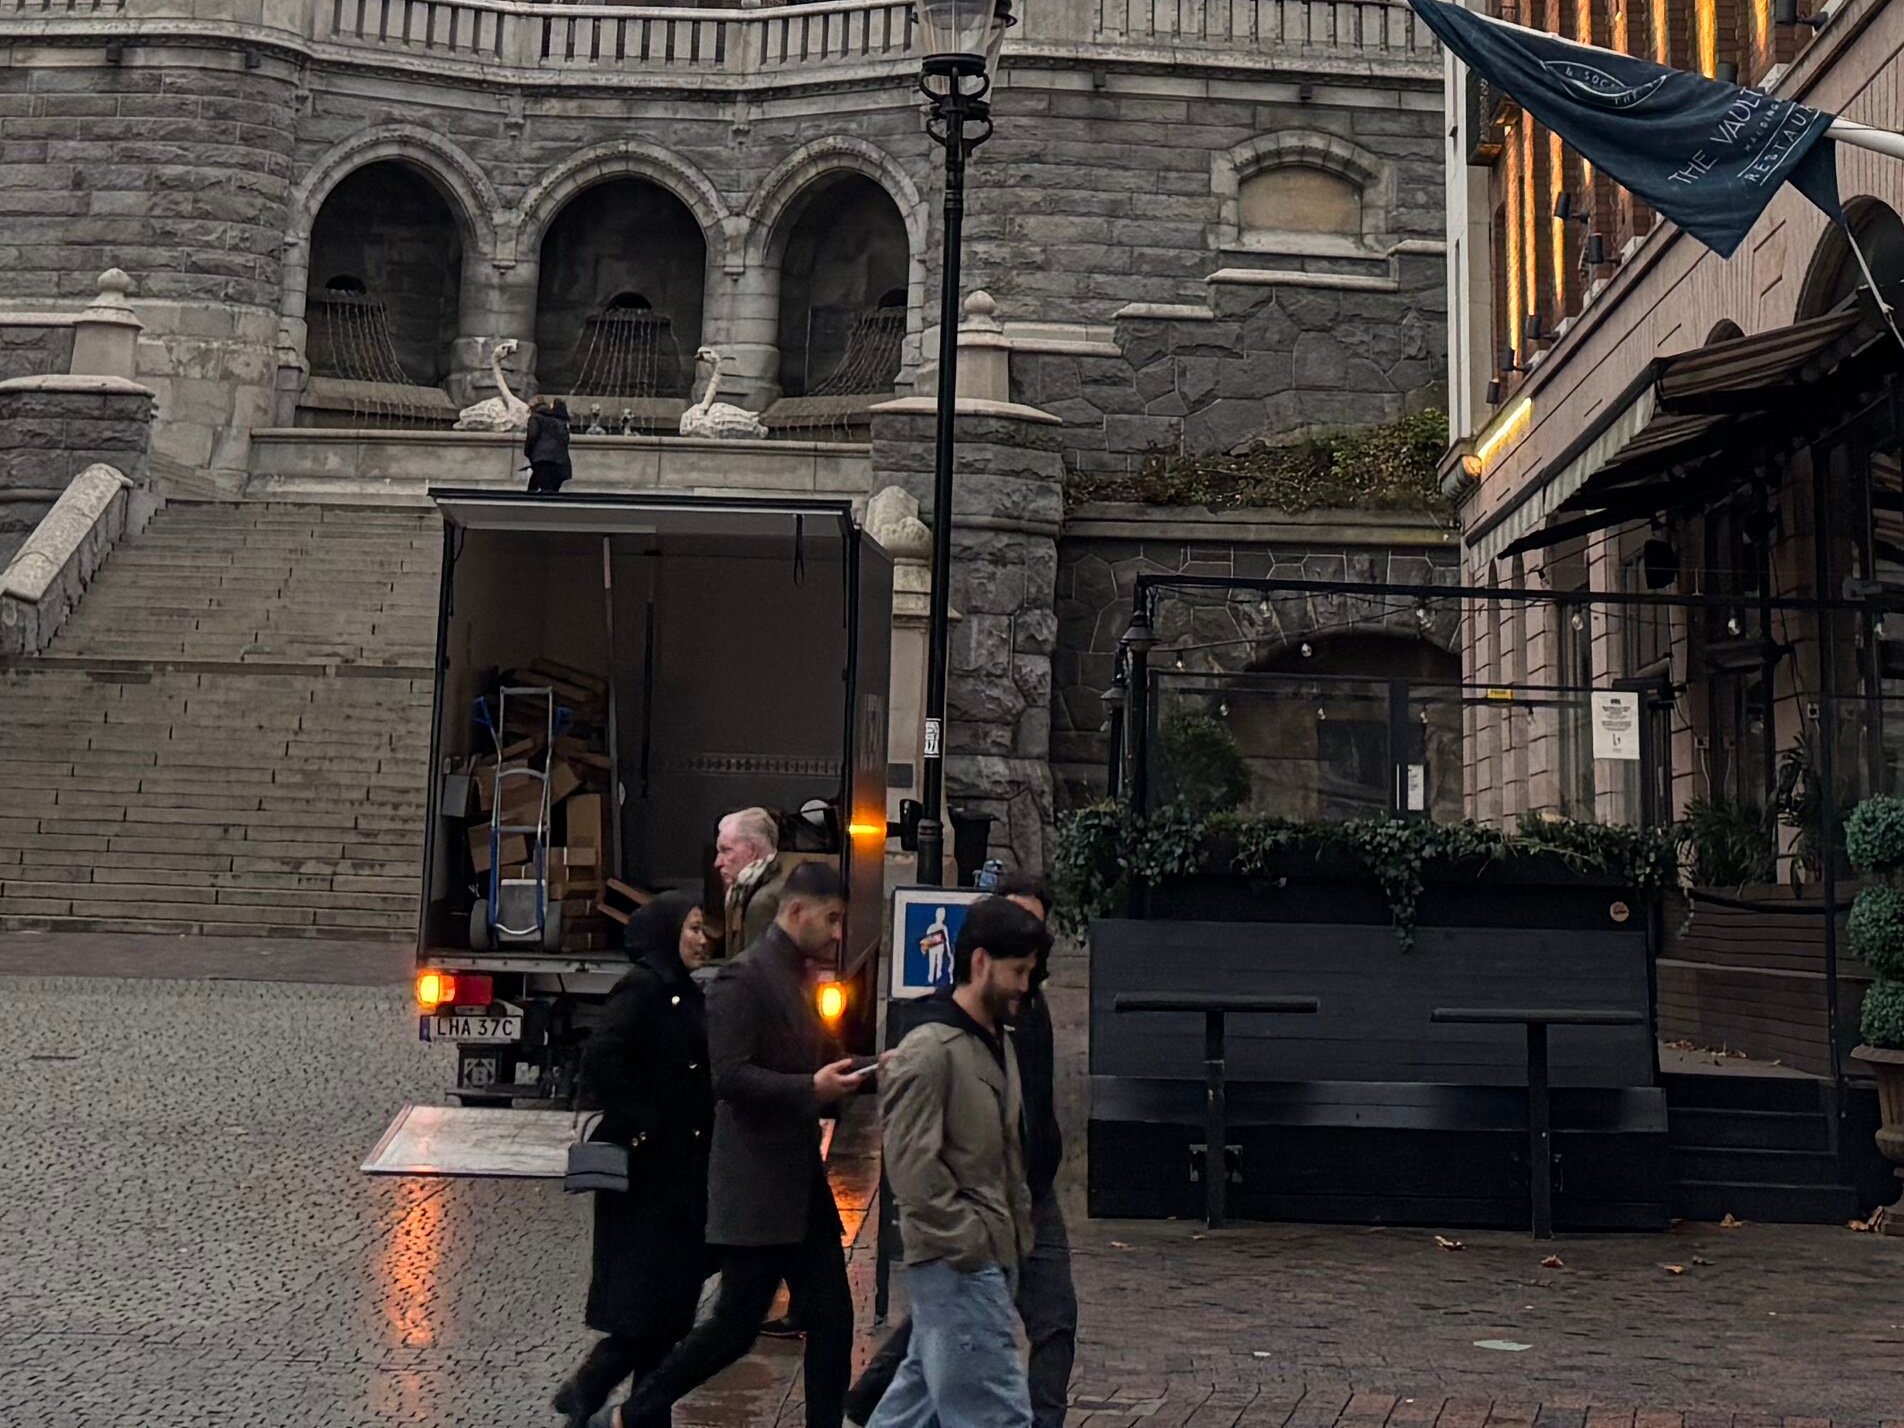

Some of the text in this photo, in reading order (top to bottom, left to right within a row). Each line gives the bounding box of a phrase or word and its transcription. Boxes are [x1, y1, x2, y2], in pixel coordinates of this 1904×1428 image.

[1668, 86, 1764, 185] THE VAULT
[437, 1019, 513, 1036] LHA 37C
